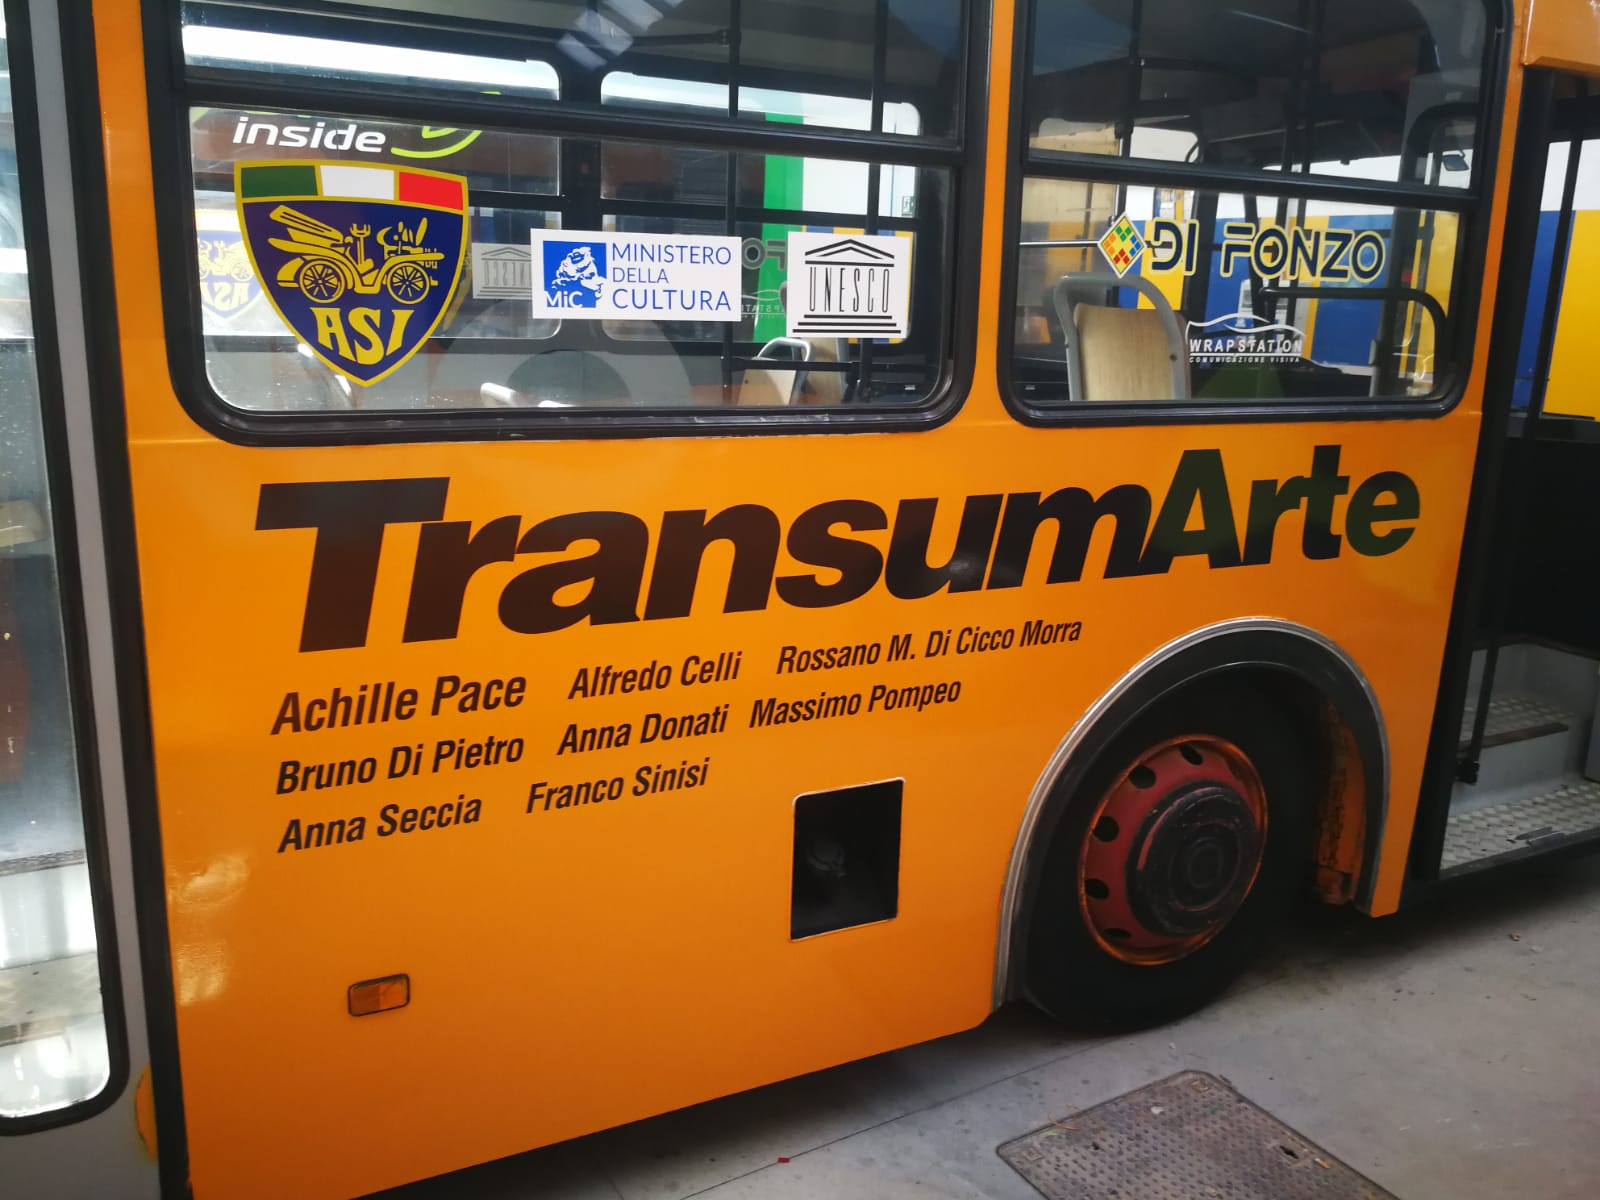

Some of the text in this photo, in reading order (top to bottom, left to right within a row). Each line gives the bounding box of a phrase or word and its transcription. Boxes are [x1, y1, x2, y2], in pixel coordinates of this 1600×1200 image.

[233, 116, 386, 153] inside
[612, 243, 731, 265] MINISTERO
[612, 267, 669, 284] DELLA
[1150, 219, 1385, 282] DI FONZO
[544, 291, 583, 309] MiC
[612, 289, 731, 312] CULTURA
[808, 266, 890, 313] UNESCO
[310, 307, 414, 365] ASI
[1188, 356, 1265, 364] COMUNICAZIONE
[256, 445, 1420, 652] TransumArte
[777, 620, 1082, 674] Rossano M. Di Cicco Morra
[567, 651, 742, 700] Alfredo Celli
[270, 675, 526, 735] Achille Pace
[556, 703, 729, 756] Anna Donati
[749, 681, 961, 728] Massimo Pompeo
[276, 735, 524, 795] Bruno Di Pietro
[526, 758, 710, 814] Franco Sinisi
[277, 794, 482, 854] Anna Seccia
